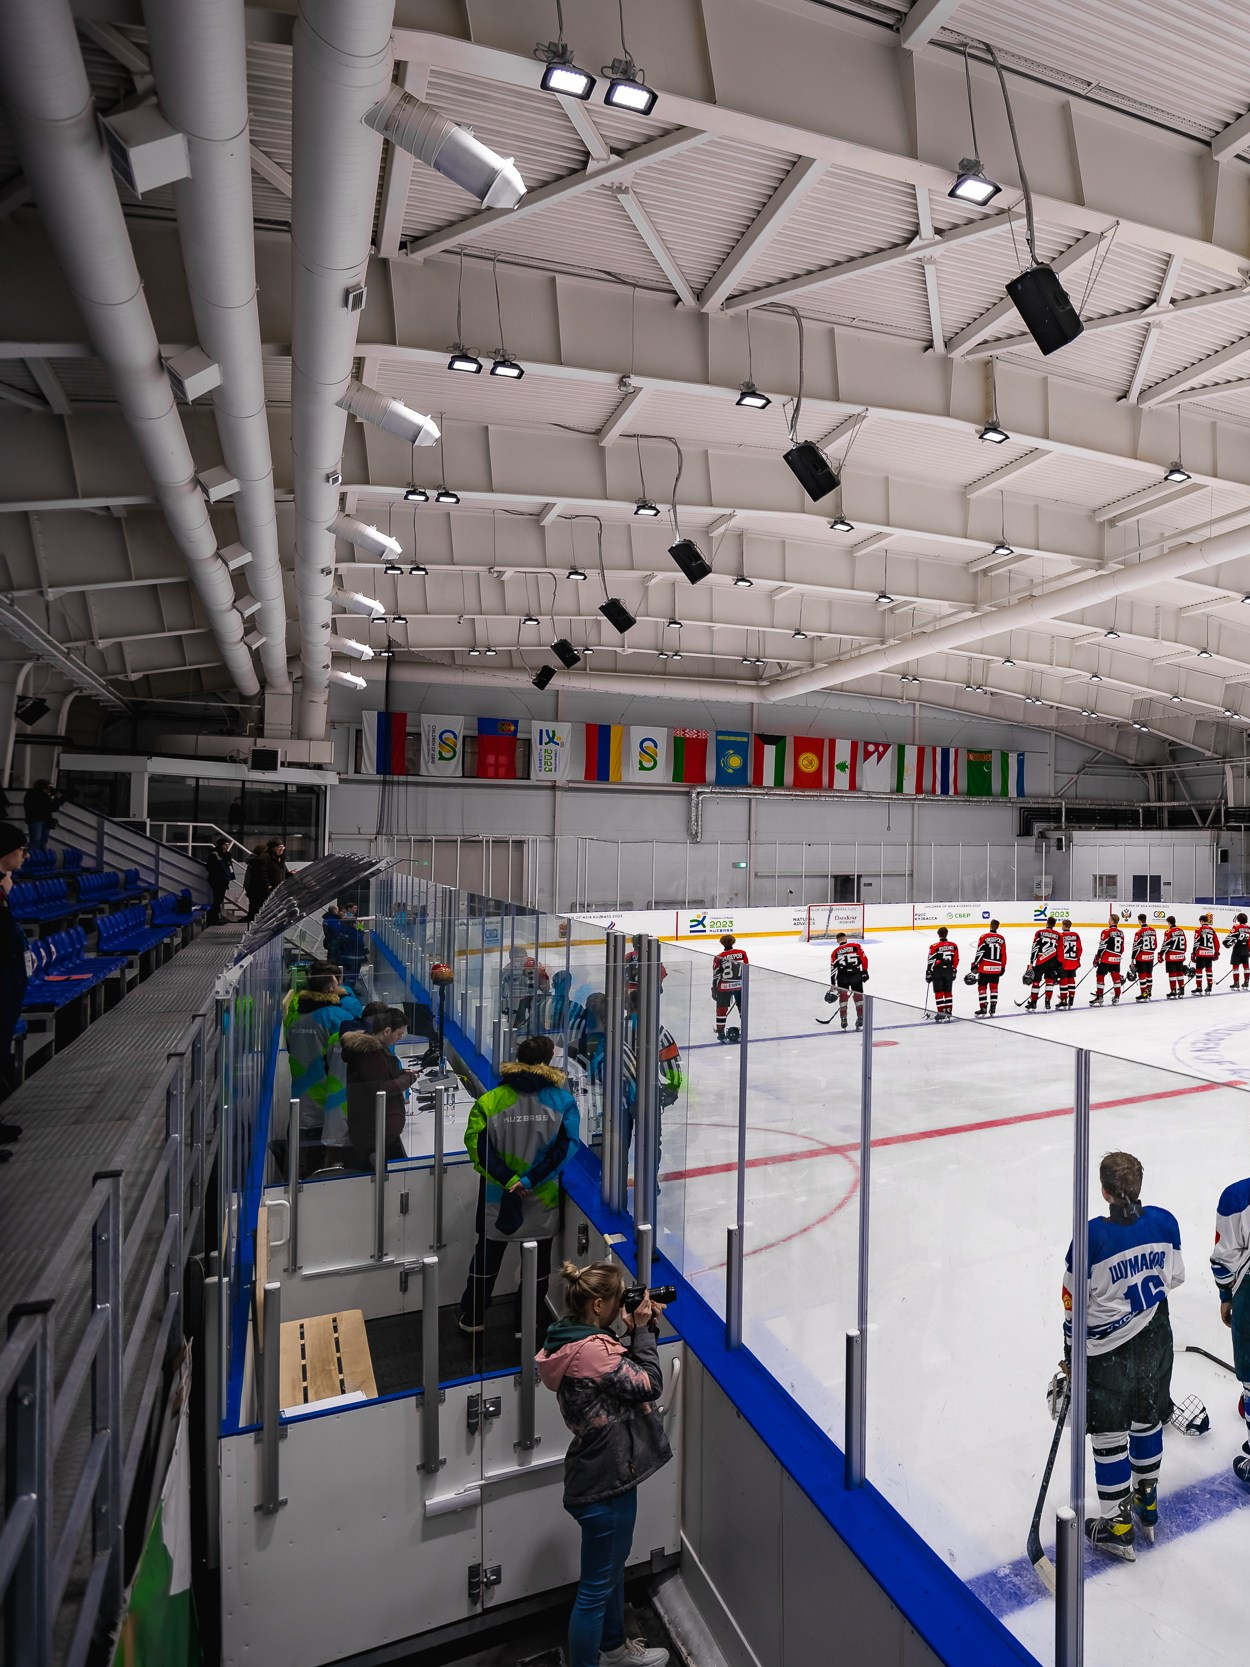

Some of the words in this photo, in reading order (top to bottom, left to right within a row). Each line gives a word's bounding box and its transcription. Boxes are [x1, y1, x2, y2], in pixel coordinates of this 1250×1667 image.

[709, 920, 734, 929] 2023
[503, 1114, 549, 1124] KUZBASS
[1122, 1274, 1167, 1312] 16
